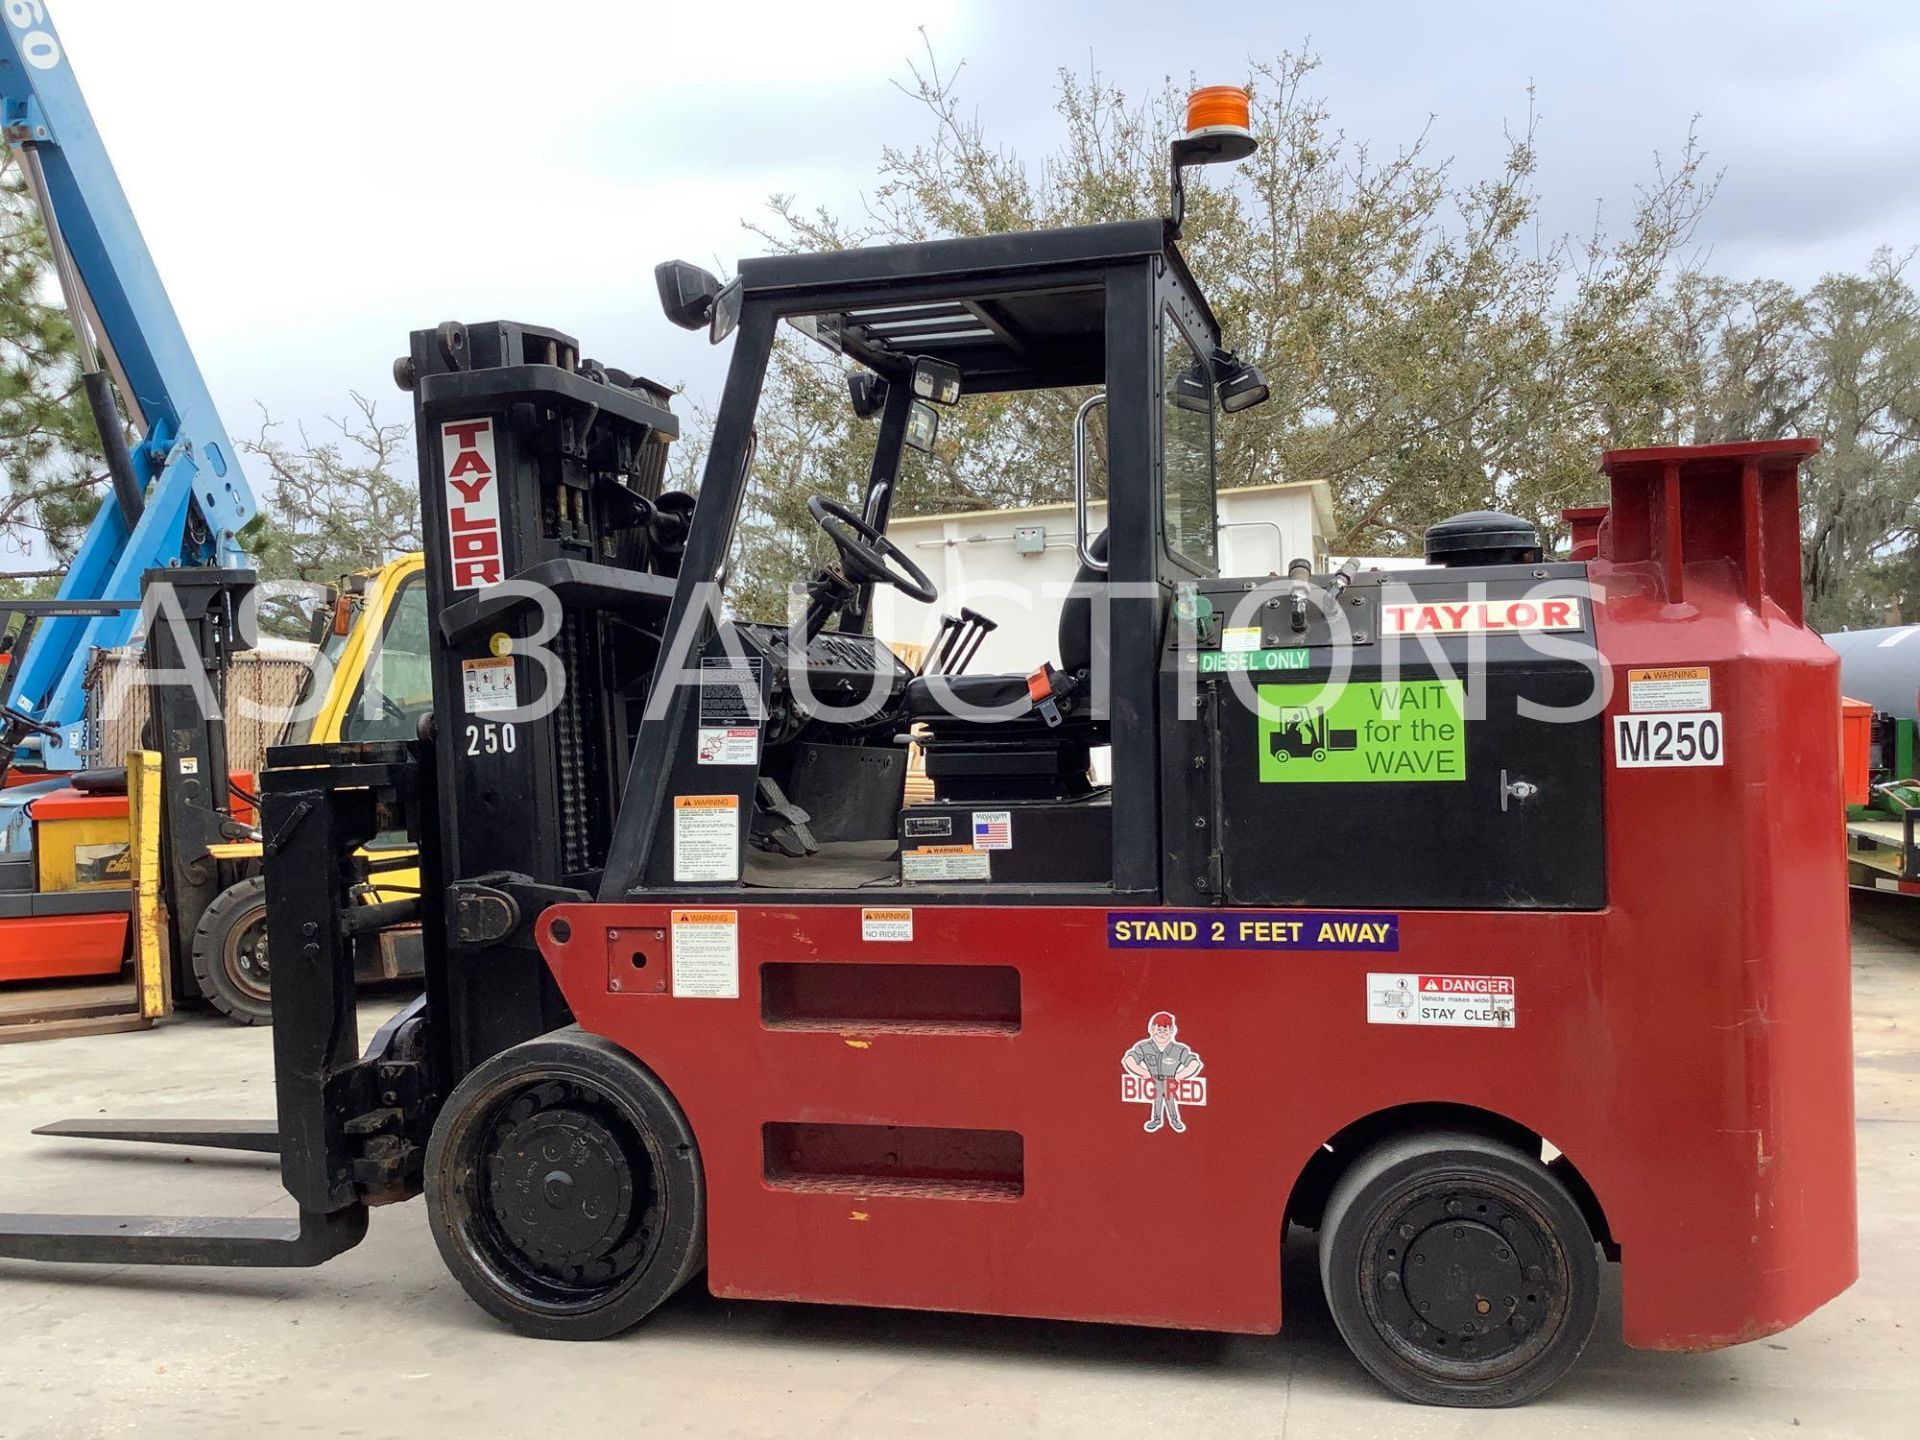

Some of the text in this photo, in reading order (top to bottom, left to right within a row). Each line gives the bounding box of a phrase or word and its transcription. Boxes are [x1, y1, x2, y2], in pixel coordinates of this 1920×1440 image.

[445, 421, 500, 587] TAYLOR
[1386, 602, 1570, 631] TAYLOR
[1202, 651, 1307, 672] DIESEL ONLY
[1653, 670, 1697, 679] WARNING
[1370, 686, 1447, 711] WAIT
[465, 723, 517, 756] 250
[1365, 718, 1455, 742] for the
[1619, 719, 1720, 762] M250
[1365, 750, 1455, 774] WAVE
[690, 914, 728, 922] WARNING
[875, 912, 909, 920] WARNING
[1115, 921, 1390, 943] STAND 2 FEET AWAY
[1442, 979, 1509, 993] DANGER
[1422, 1008, 1511, 1022] STAY CLEAR
[1124, 1076, 1204, 1102] BIG RED
